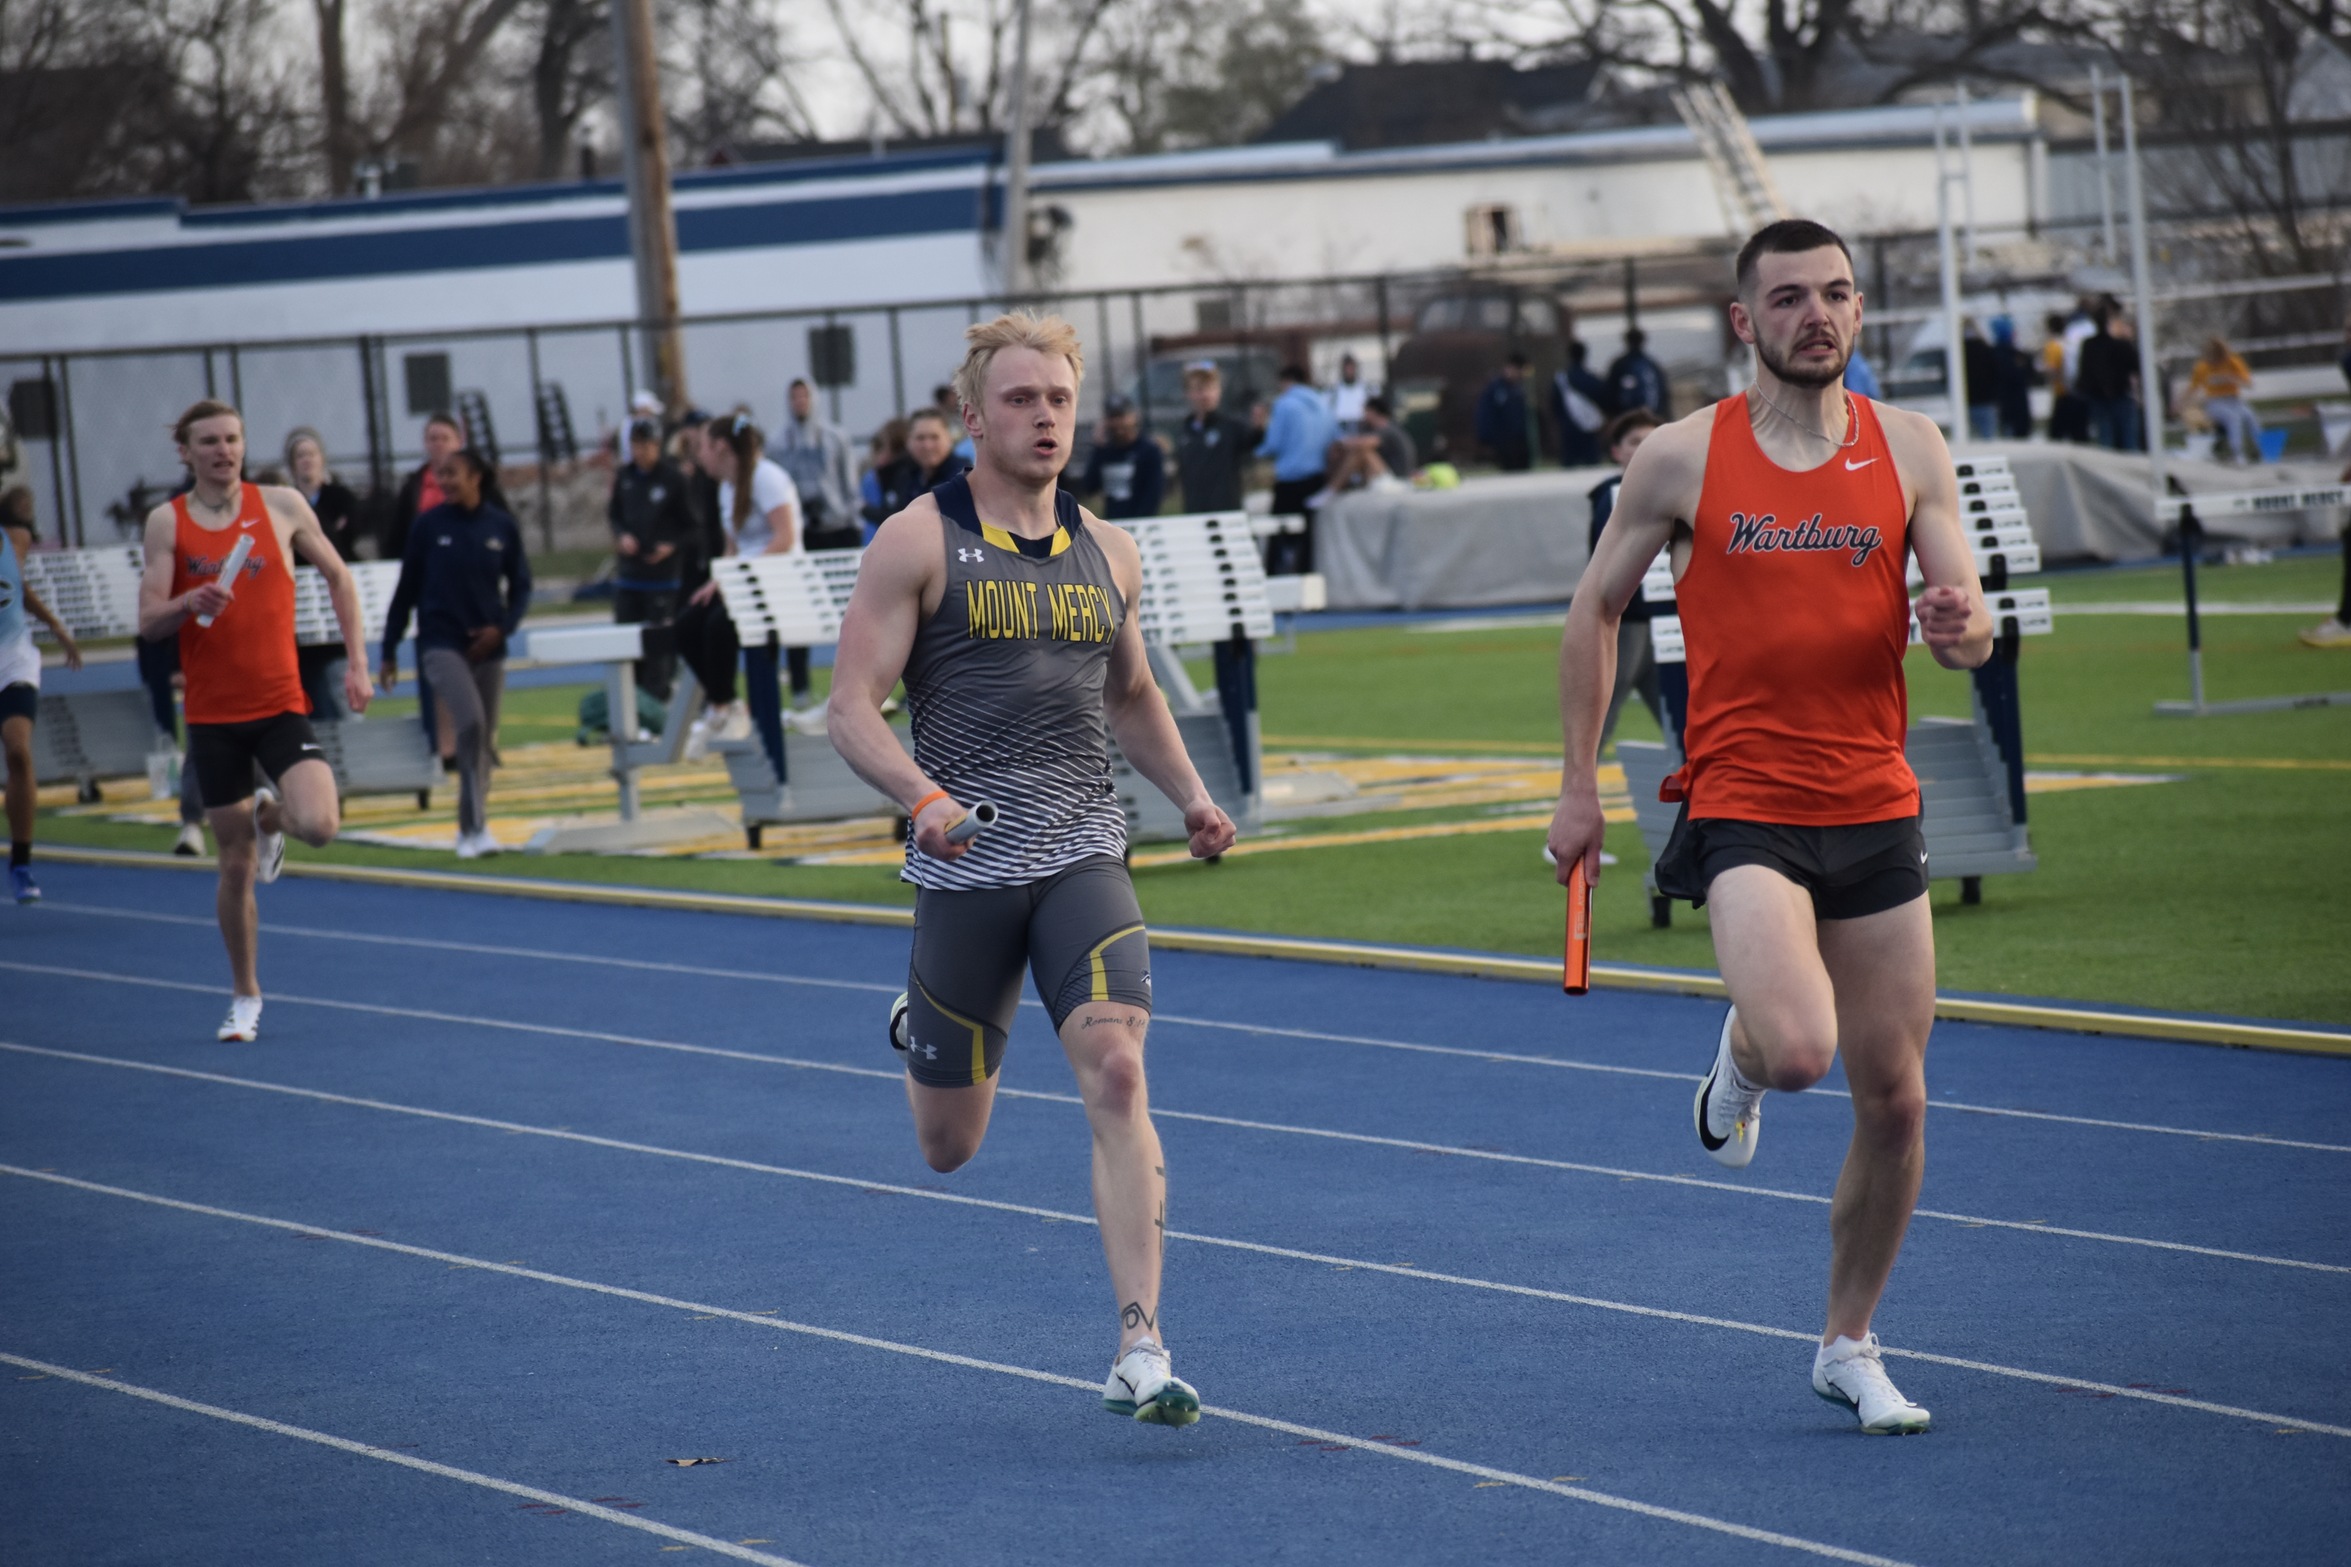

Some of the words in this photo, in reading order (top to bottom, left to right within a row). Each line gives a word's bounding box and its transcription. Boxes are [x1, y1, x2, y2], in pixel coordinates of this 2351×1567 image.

[1726, 512, 1883, 568] Wartburg
[966, 579, 1039, 640] MOUNT
[1046, 583, 1116, 645] MERCY
